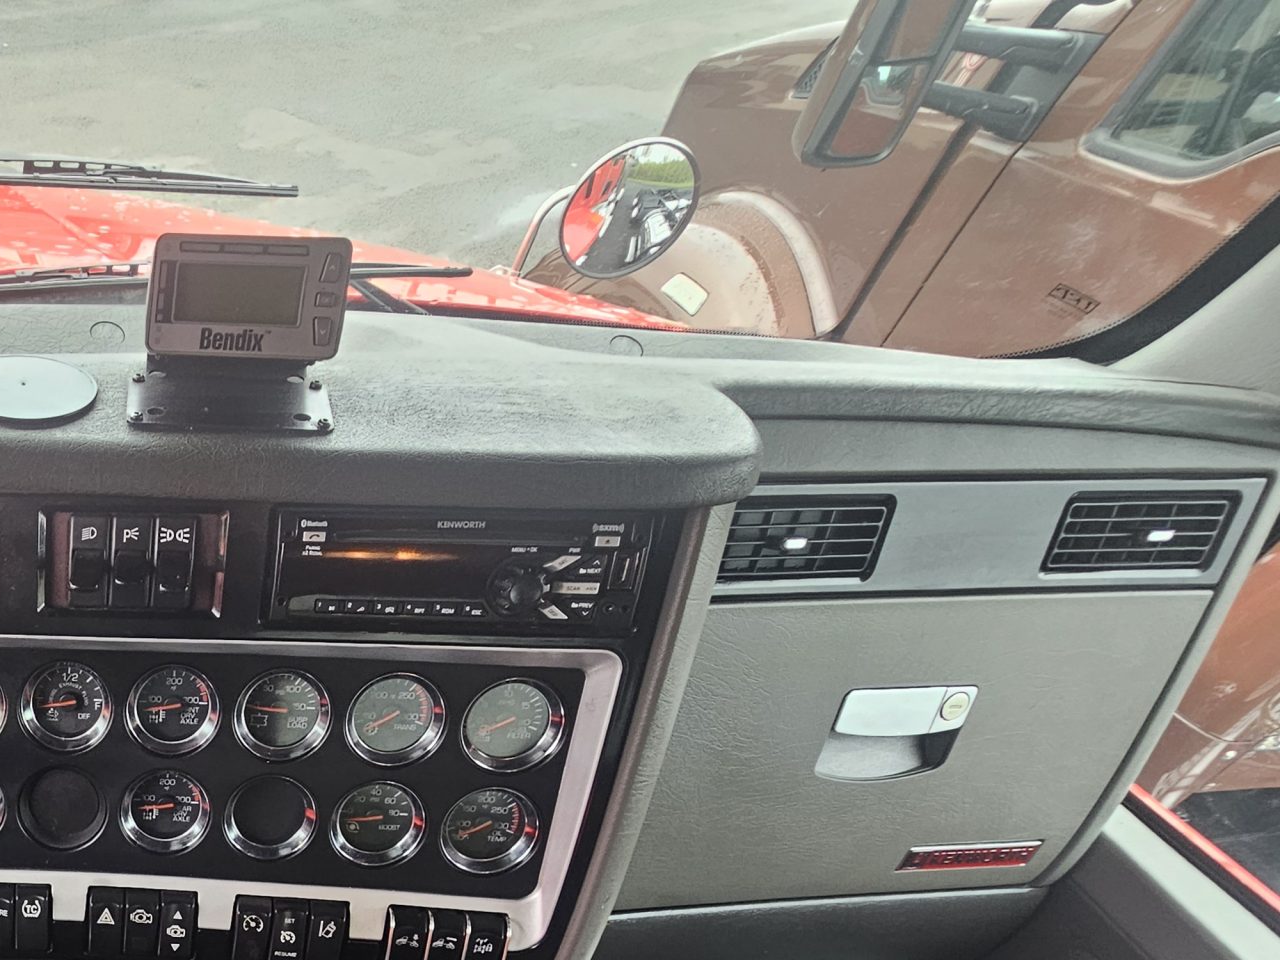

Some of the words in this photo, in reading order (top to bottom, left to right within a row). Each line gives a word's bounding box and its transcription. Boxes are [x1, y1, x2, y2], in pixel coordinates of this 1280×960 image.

[199, 327, 264, 352] Bendix
[437, 521, 486, 529] KENWORTH
[62, 673, 79, 683] 1/2
[166, 678, 183, 686] 200
[286, 685, 302, 693] 100
[94, 702, 101, 710] F
[490, 807, 508, 815] 250
[25, 904, 38, 914] TC
